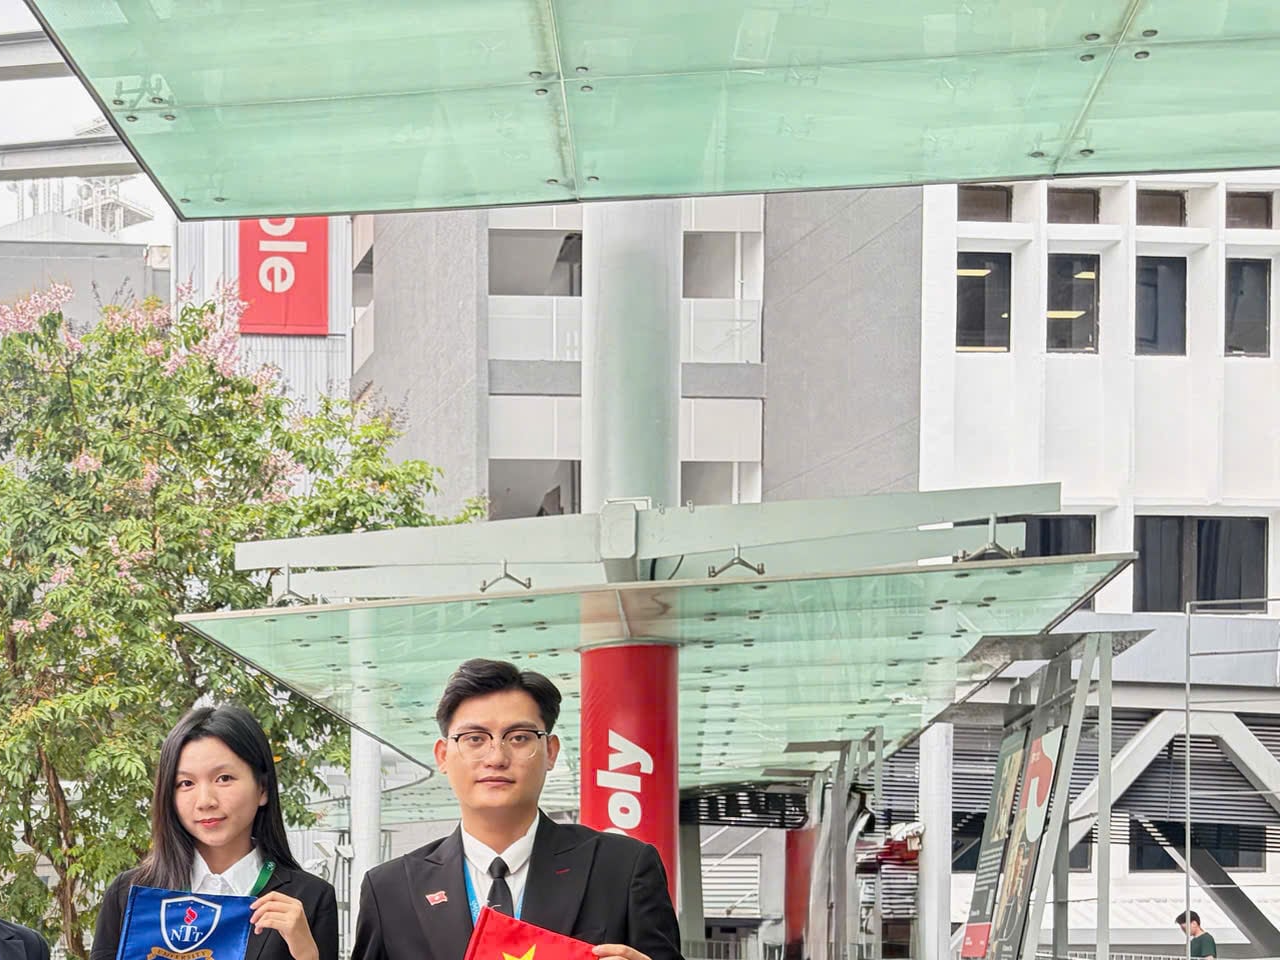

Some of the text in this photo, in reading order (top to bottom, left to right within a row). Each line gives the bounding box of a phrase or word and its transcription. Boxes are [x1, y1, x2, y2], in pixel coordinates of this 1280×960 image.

[596, 728, 654, 836] oly
[170, 924, 204, 942] NTT
[157, 949, 208, 960] UNIVERSITY
